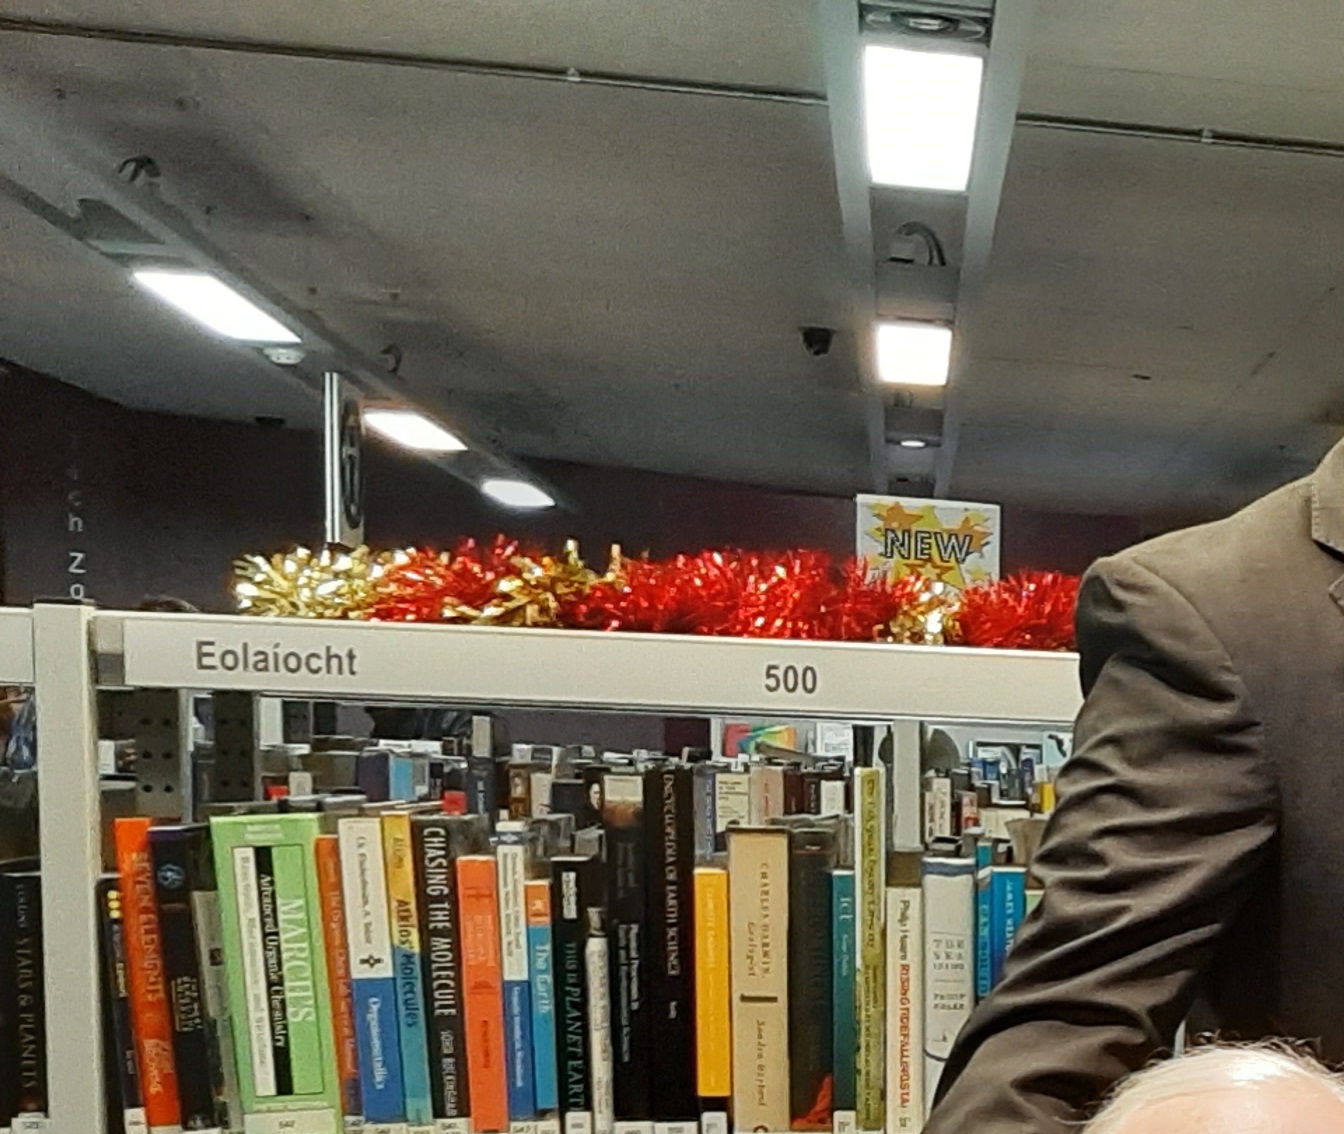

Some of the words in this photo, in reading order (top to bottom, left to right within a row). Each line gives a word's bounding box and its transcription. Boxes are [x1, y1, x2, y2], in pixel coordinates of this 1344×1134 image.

[884, 527, 973, 564] NEW
[196, 639, 357, 677] Eolaíocht
[764, 663, 818, 695] 500
[423, 827, 450, 896] CHASING
[665, 866, 678, 882] OF
[428, 902, 452, 930] THE
[666, 885, 678, 923] EARTH
[535, 944, 551, 969] The
[402, 953, 420, 1028] Molecules
[431, 937, 457, 1017] MOLECULE
[537, 974, 553, 1014] Earth
[18, 994, 34, 1007] &
[565, 985, 587, 1056] PLANET
[18, 1014, 38, 1088] PLANETS
